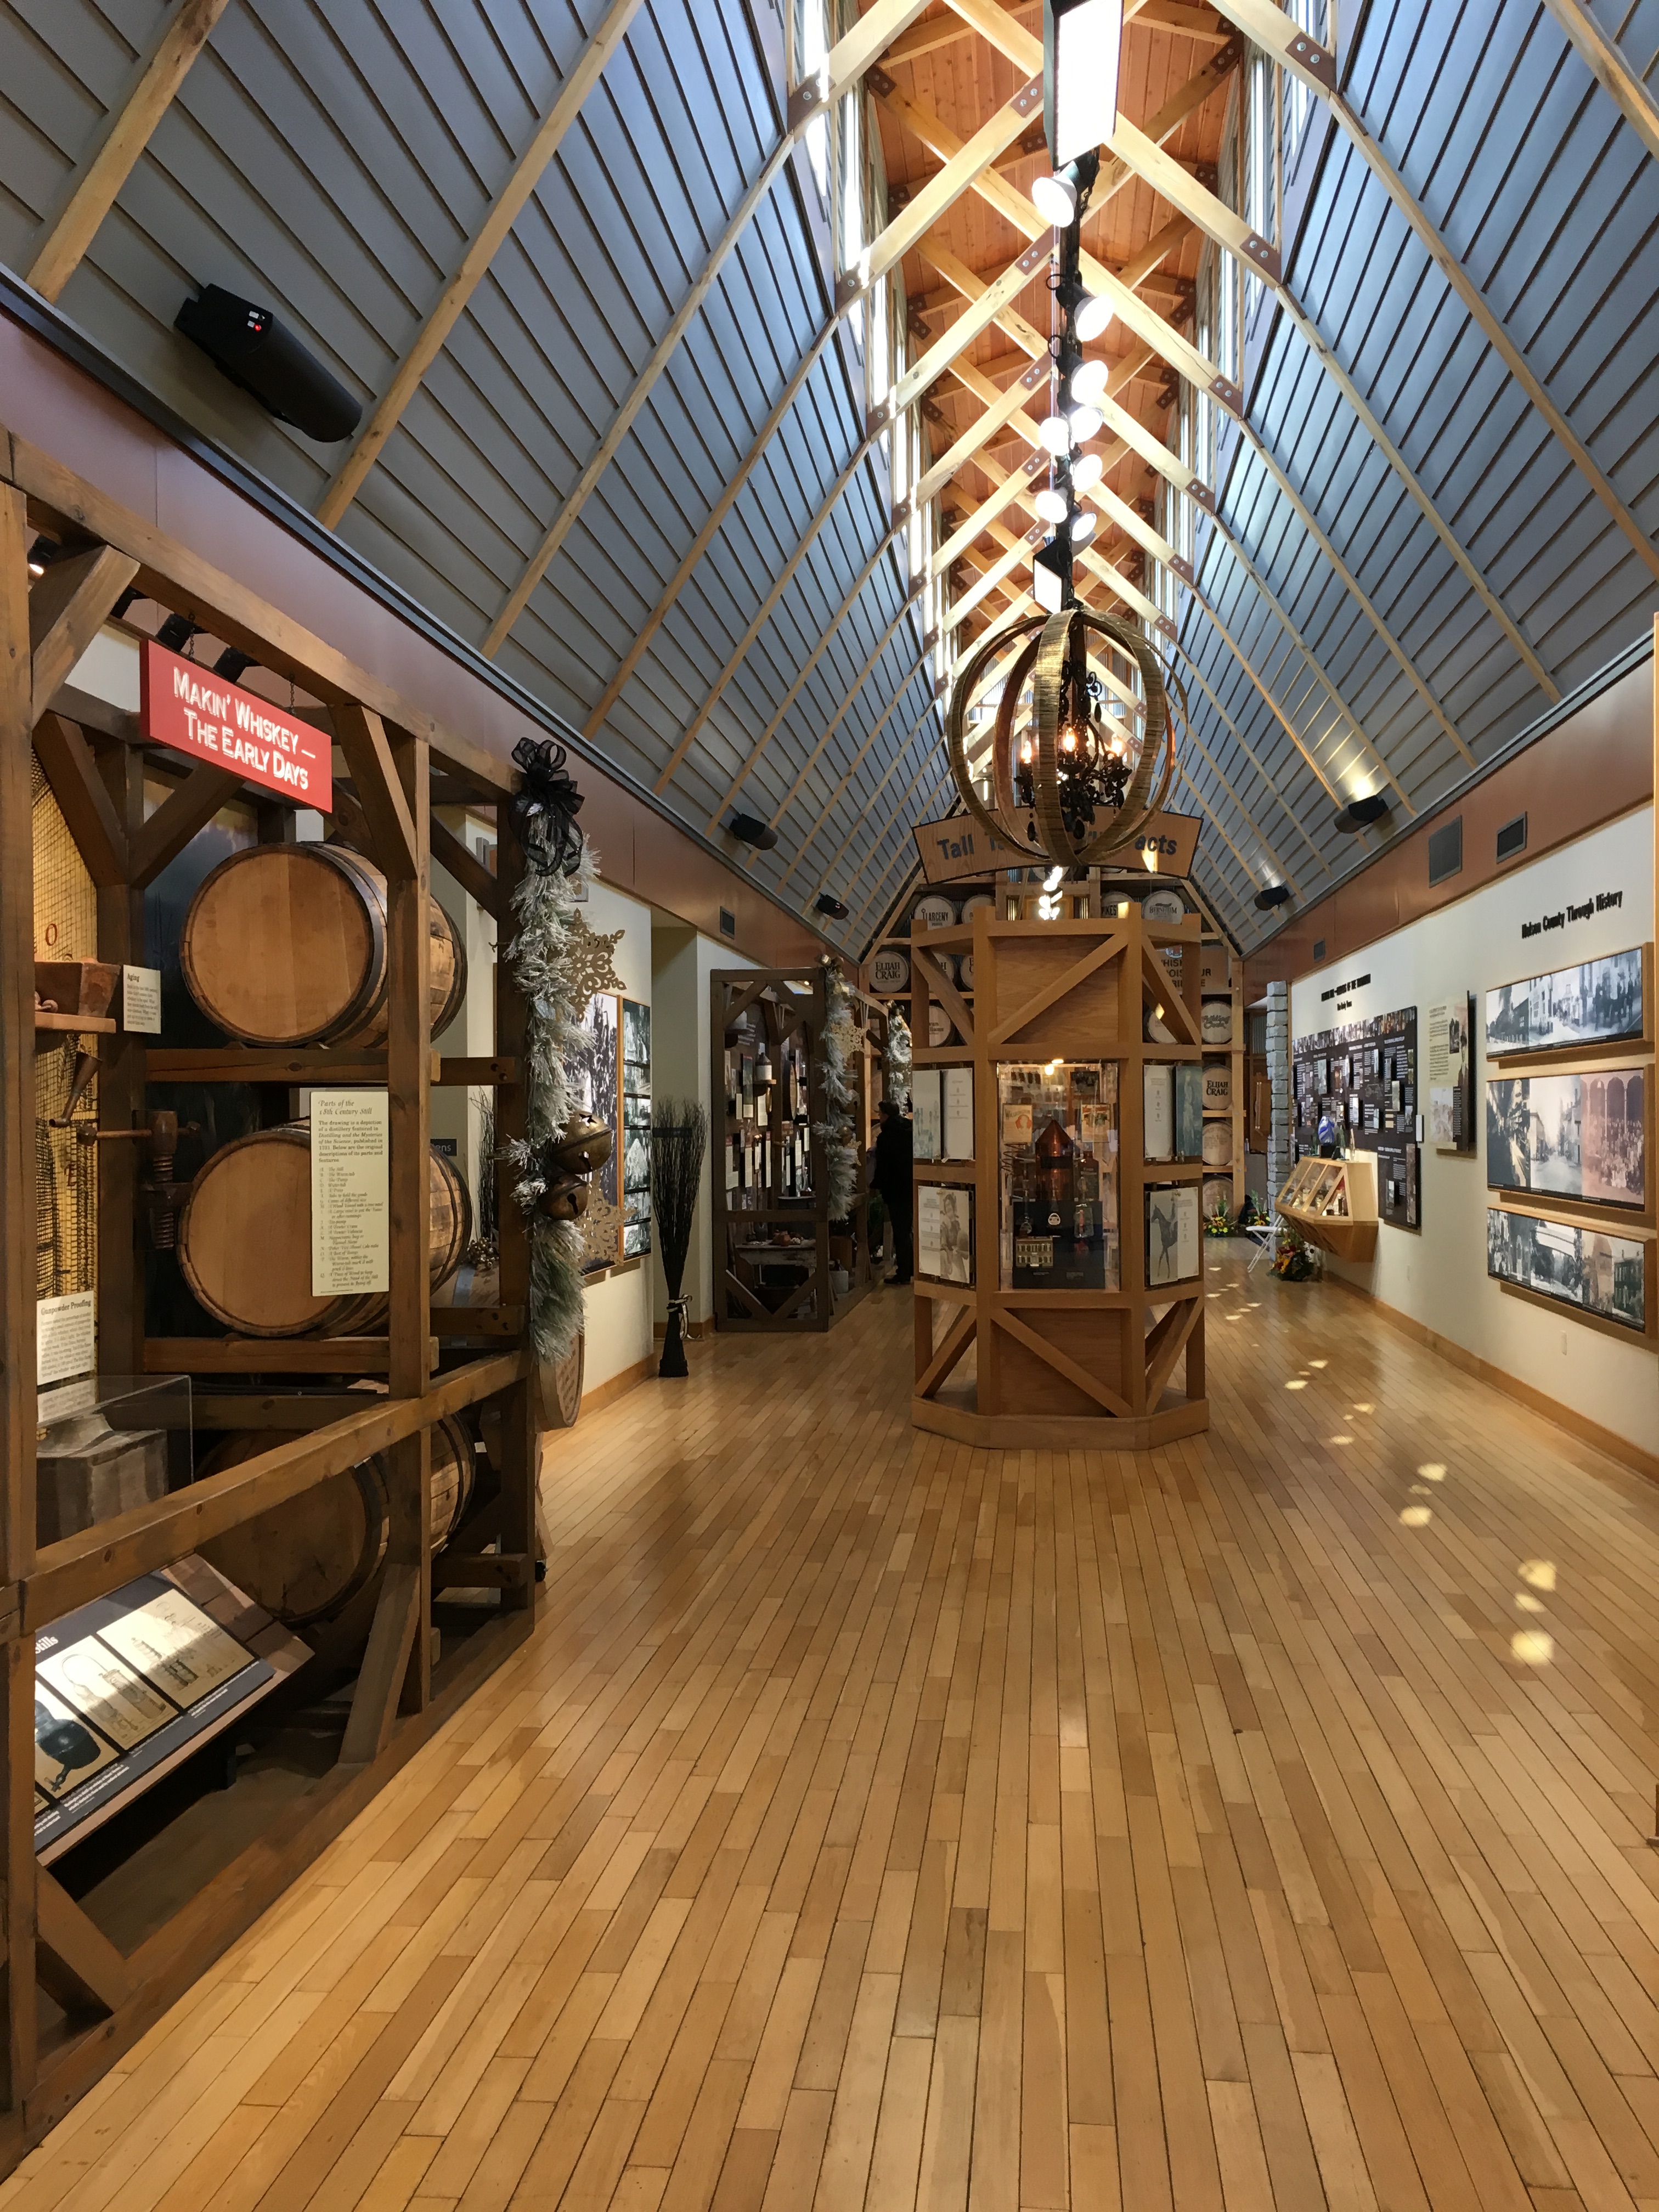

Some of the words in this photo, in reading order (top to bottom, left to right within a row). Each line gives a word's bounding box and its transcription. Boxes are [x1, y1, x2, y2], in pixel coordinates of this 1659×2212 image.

[235, 698, 298, 754] WHISKEY
[184, 707, 218, 751] THE
[222, 725, 269, 772] EARLY
[273, 750, 308, 789] DAYS
[937, 834, 974, 860] Tall
[1135, 834, 1177, 855] acts
[1543, 912, 1565, 932] County
[1566, 898, 1594, 923] Through
[1596, 891, 1622, 912] History
[875, 970, 901, 980] CRAIG
[876, 962, 900, 970] ELIJAH
[127, 973, 139, 983] Aging
[1206, 1087, 1228, 1096] CRAIG
[41, 1304, 70, 1315] Gunpowder
[71, 1299, 91, 1309] Proofing
